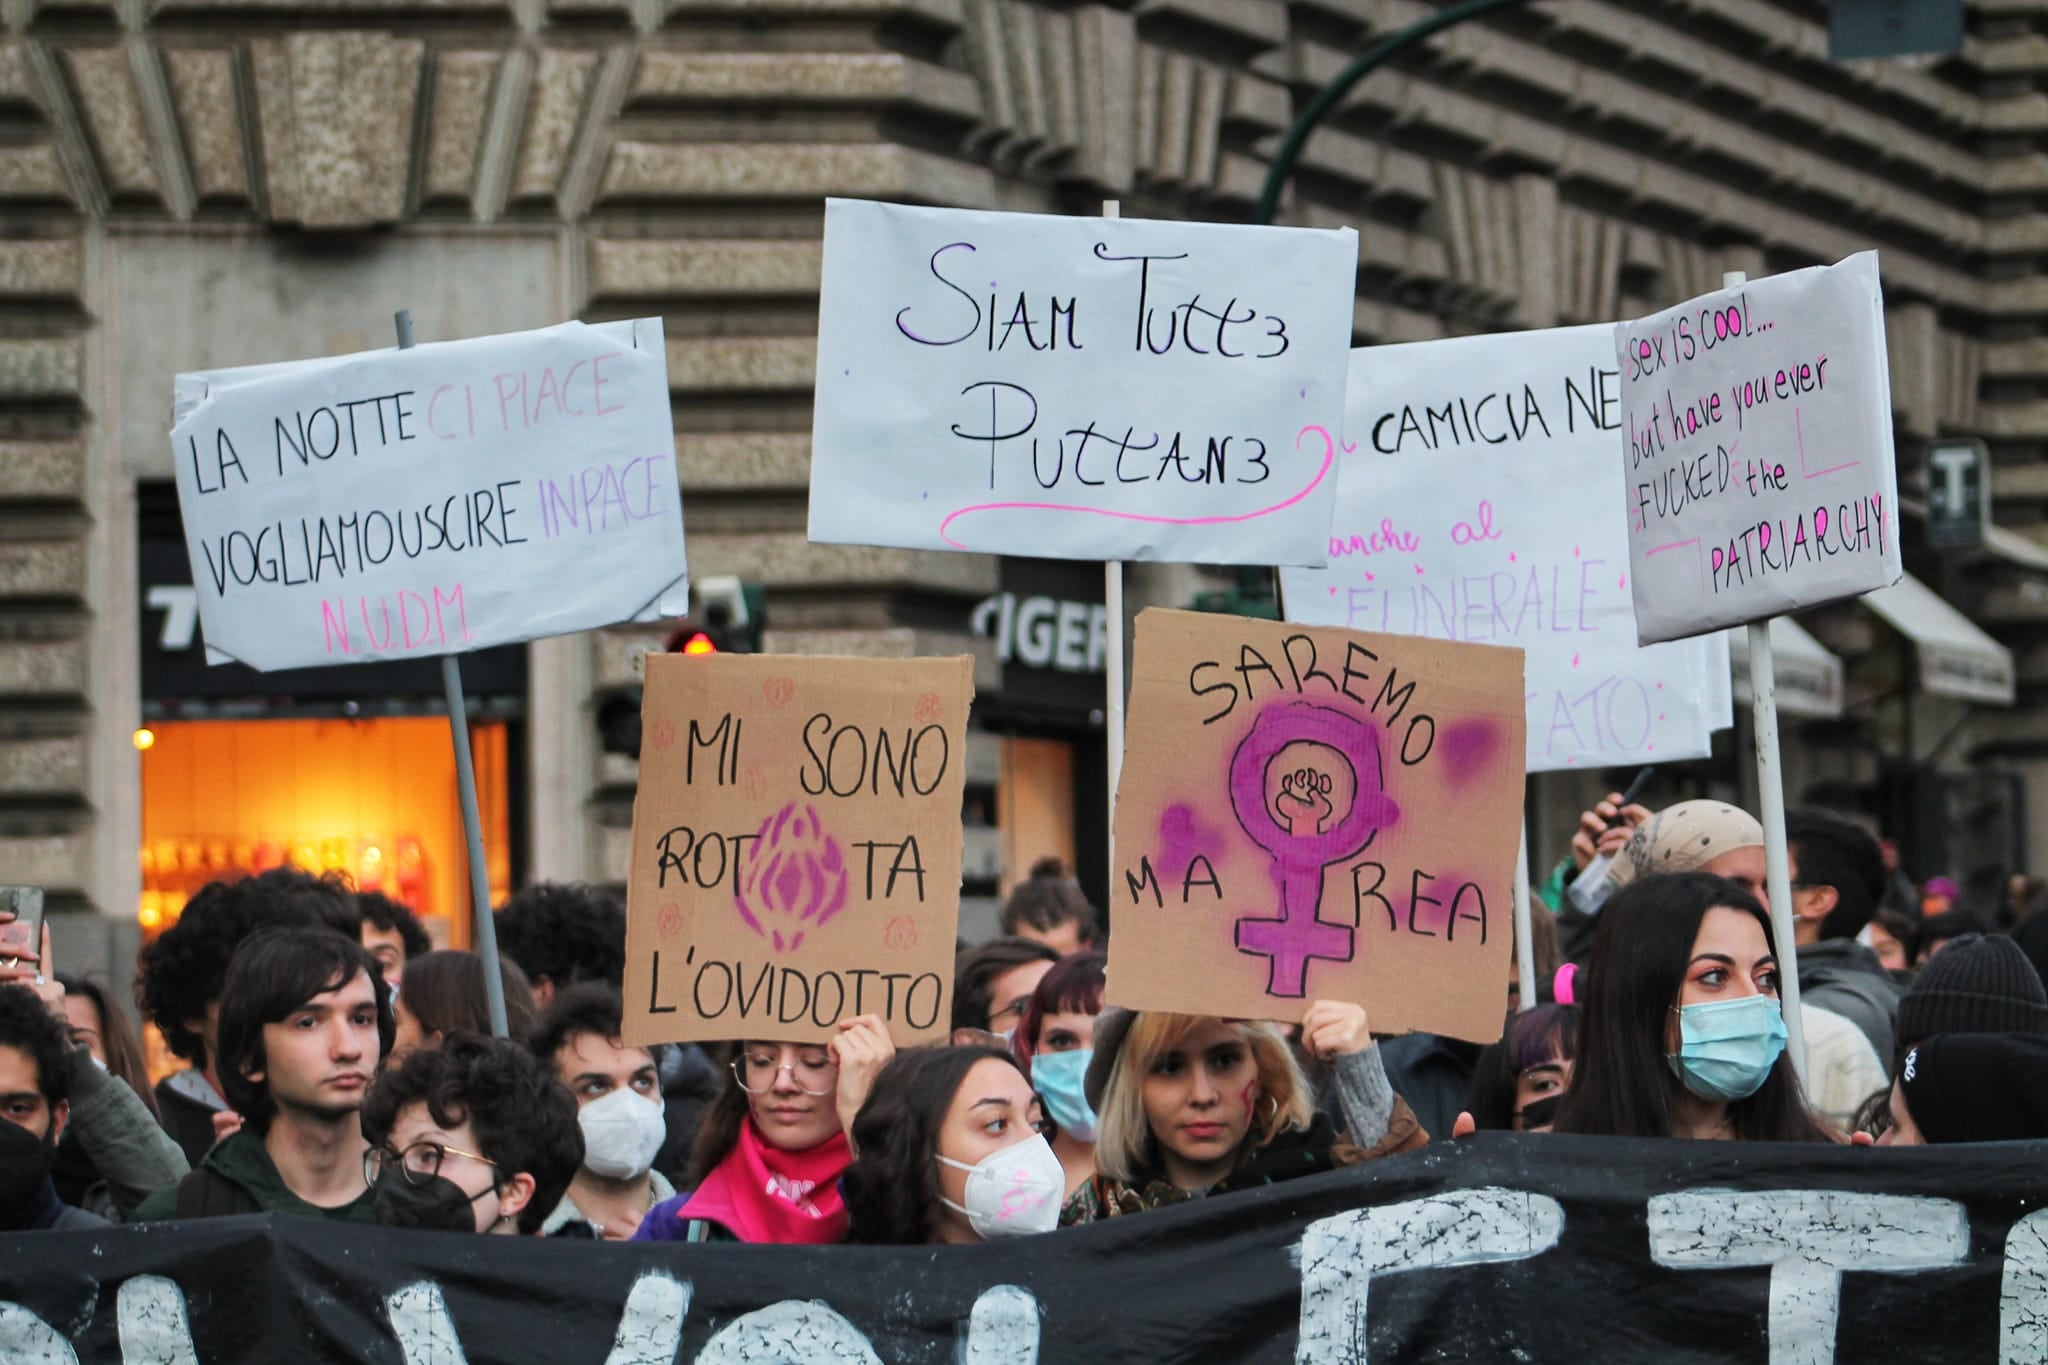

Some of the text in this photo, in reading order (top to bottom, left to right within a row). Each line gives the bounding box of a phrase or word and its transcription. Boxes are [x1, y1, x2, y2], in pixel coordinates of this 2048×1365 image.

[190, 352, 625, 494] LA NOTTE CI PIACE
[1371, 383, 1551, 454] CAMICIA
[1630, 358, 1829, 469] but have you ever
[1328, 500, 1503, 558] anche al
[1638, 444, 1789, 529] FUCKED the
[1711, 495, 1883, 594] PATRIARCHY
[1189, 634, 1436, 767] SAREMO
[1526, 673, 1651, 757] ATO
[686, 712, 949, 798] MI SONO
[648, 945, 943, 1030] L'OVIDOTTO
